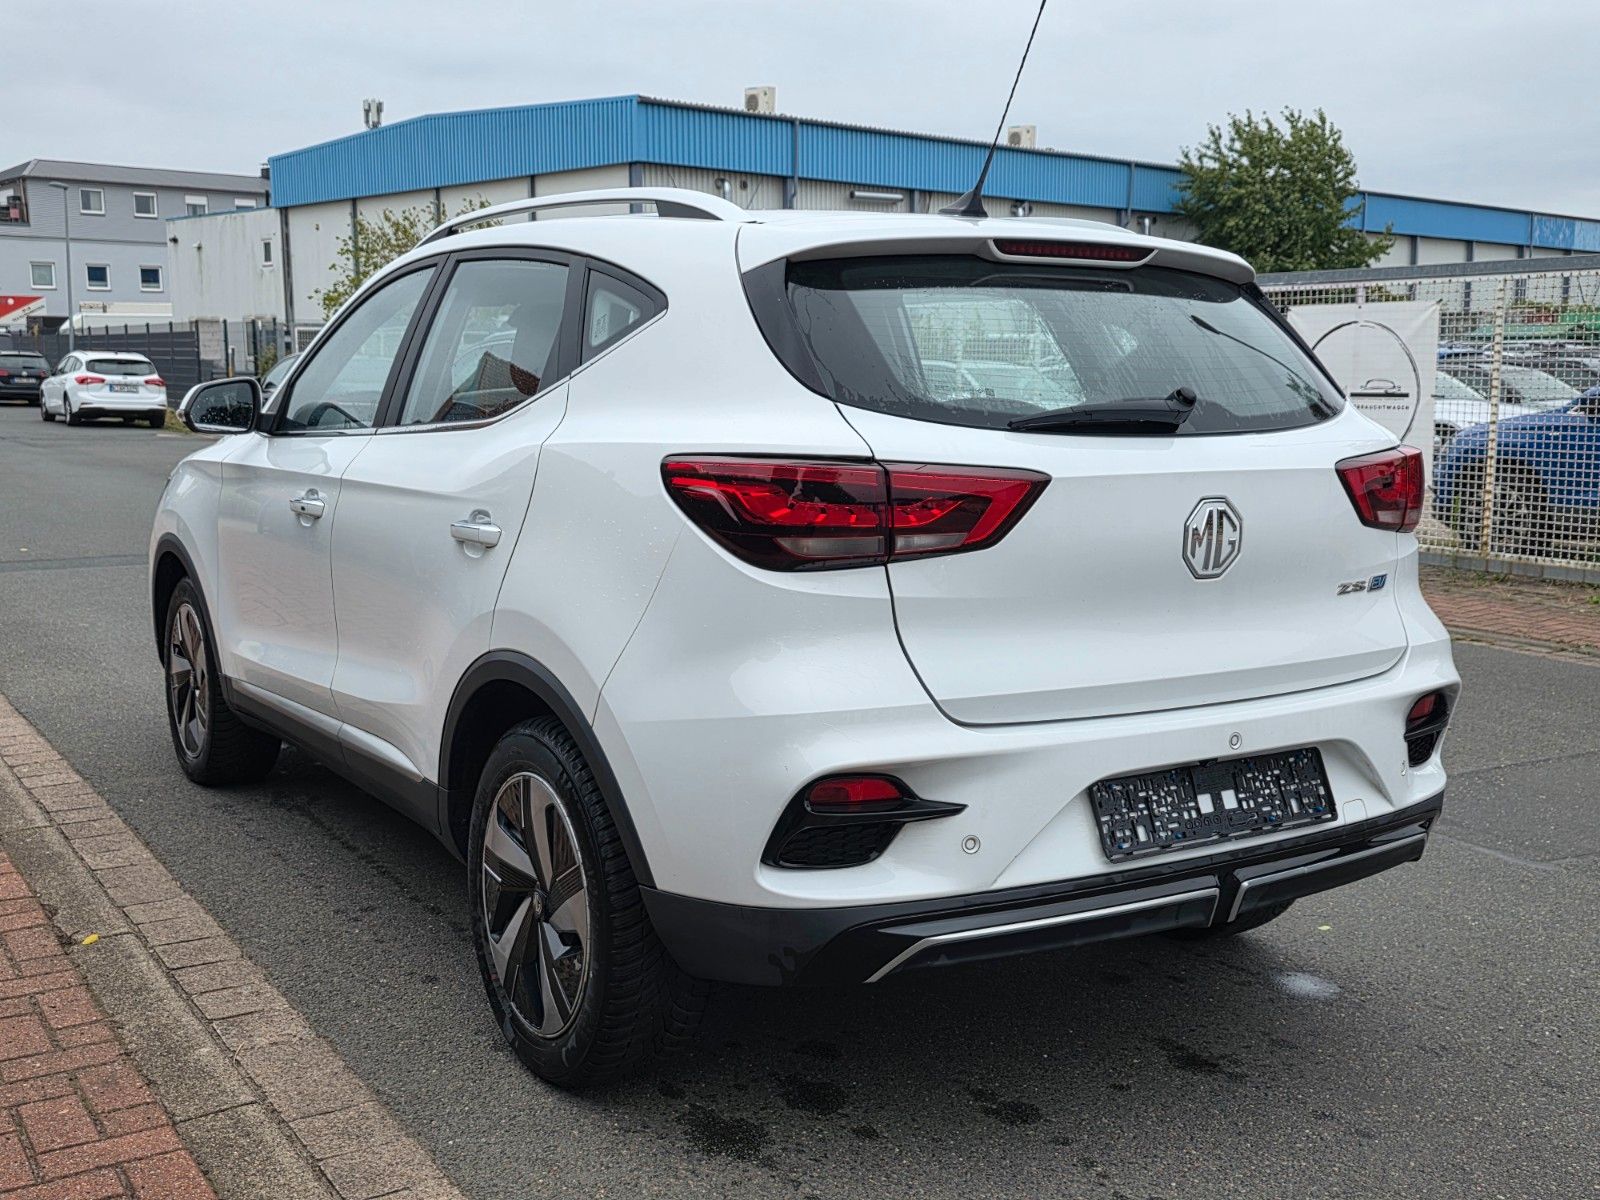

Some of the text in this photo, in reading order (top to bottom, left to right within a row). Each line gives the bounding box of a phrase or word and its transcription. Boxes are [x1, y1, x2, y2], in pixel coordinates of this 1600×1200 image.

[1189, 505, 1238, 571] MG
[1337, 574, 1387, 595] ZS EV
